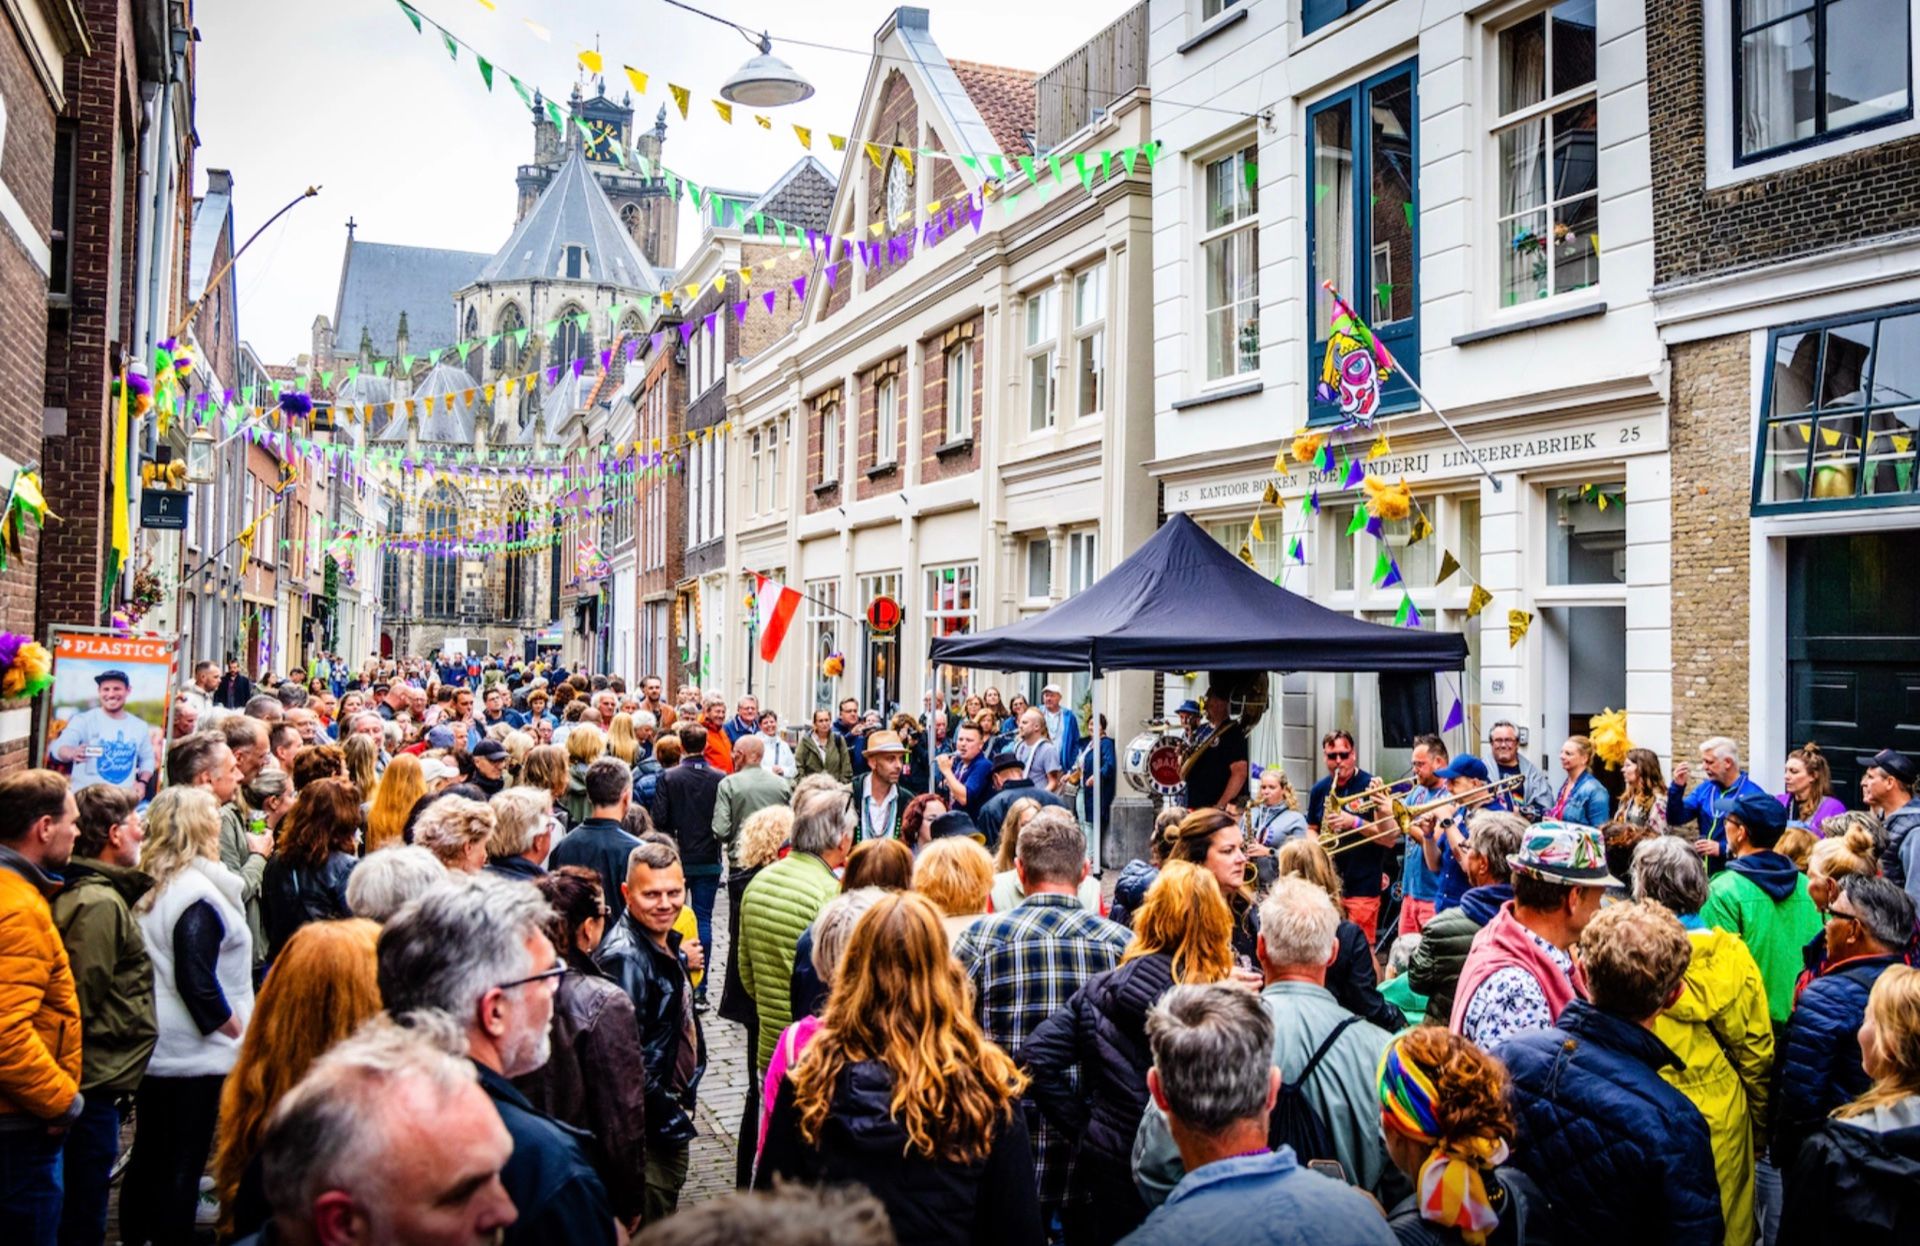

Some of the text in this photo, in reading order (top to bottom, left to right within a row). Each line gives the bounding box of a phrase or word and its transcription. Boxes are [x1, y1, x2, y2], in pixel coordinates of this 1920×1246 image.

[1199, 482, 1250, 500] KANTOOR
[1252, 474, 1298, 493] BOKEN
[1308, 454, 1429, 486] BOEINDERIJ
[1619, 426, 1641, 444] 25
[75, 640, 154, 657] PLASTIC
